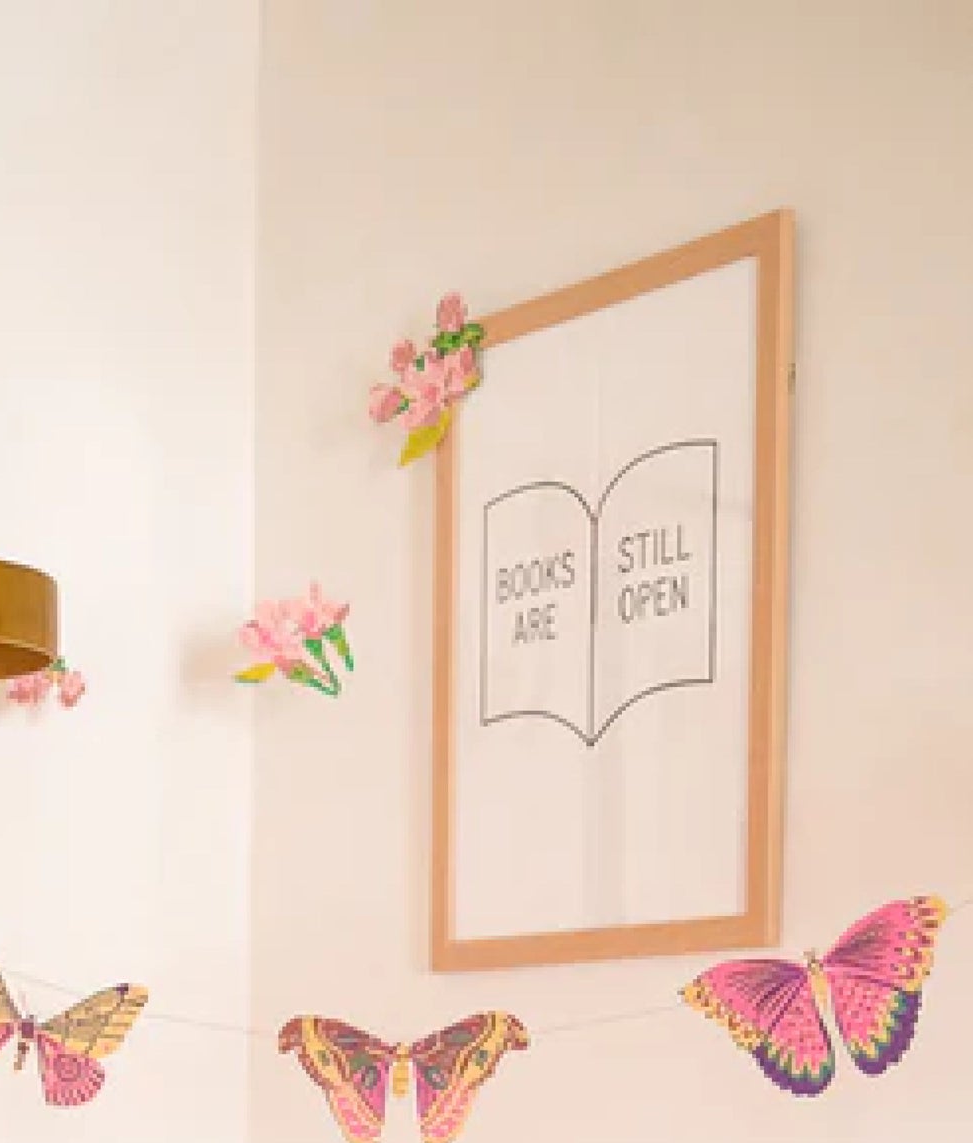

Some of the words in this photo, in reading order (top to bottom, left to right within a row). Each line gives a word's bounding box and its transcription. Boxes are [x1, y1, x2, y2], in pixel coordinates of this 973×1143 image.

[618, 525, 693, 574] STILL
[496, 550, 575, 603] BOOKS
[618, 576, 689, 624] OPEN
[512, 603, 557, 645] ARE
